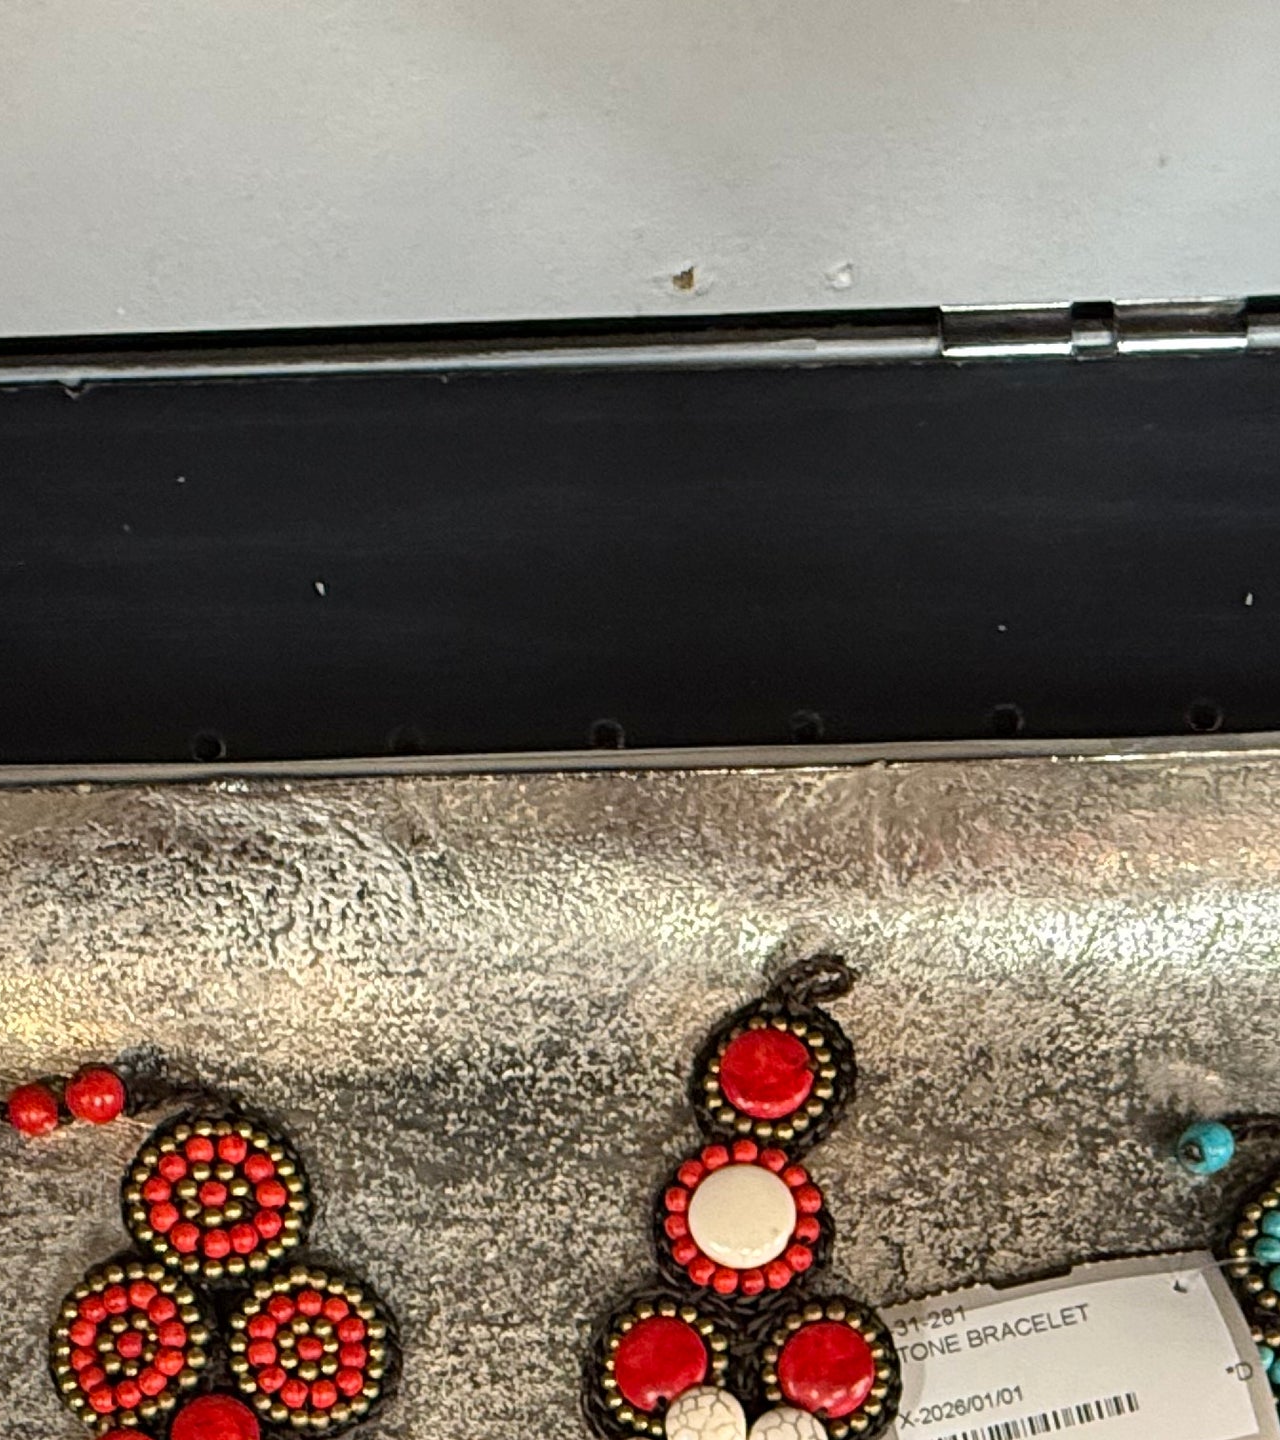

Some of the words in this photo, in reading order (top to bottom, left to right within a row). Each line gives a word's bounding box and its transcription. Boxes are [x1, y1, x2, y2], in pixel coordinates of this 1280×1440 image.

[897, 1333, 962, 1364] TONE
[966, 1302, 1090, 1349] BRACELET
[899, 1385, 1024, 1429] X-2026/01/01
